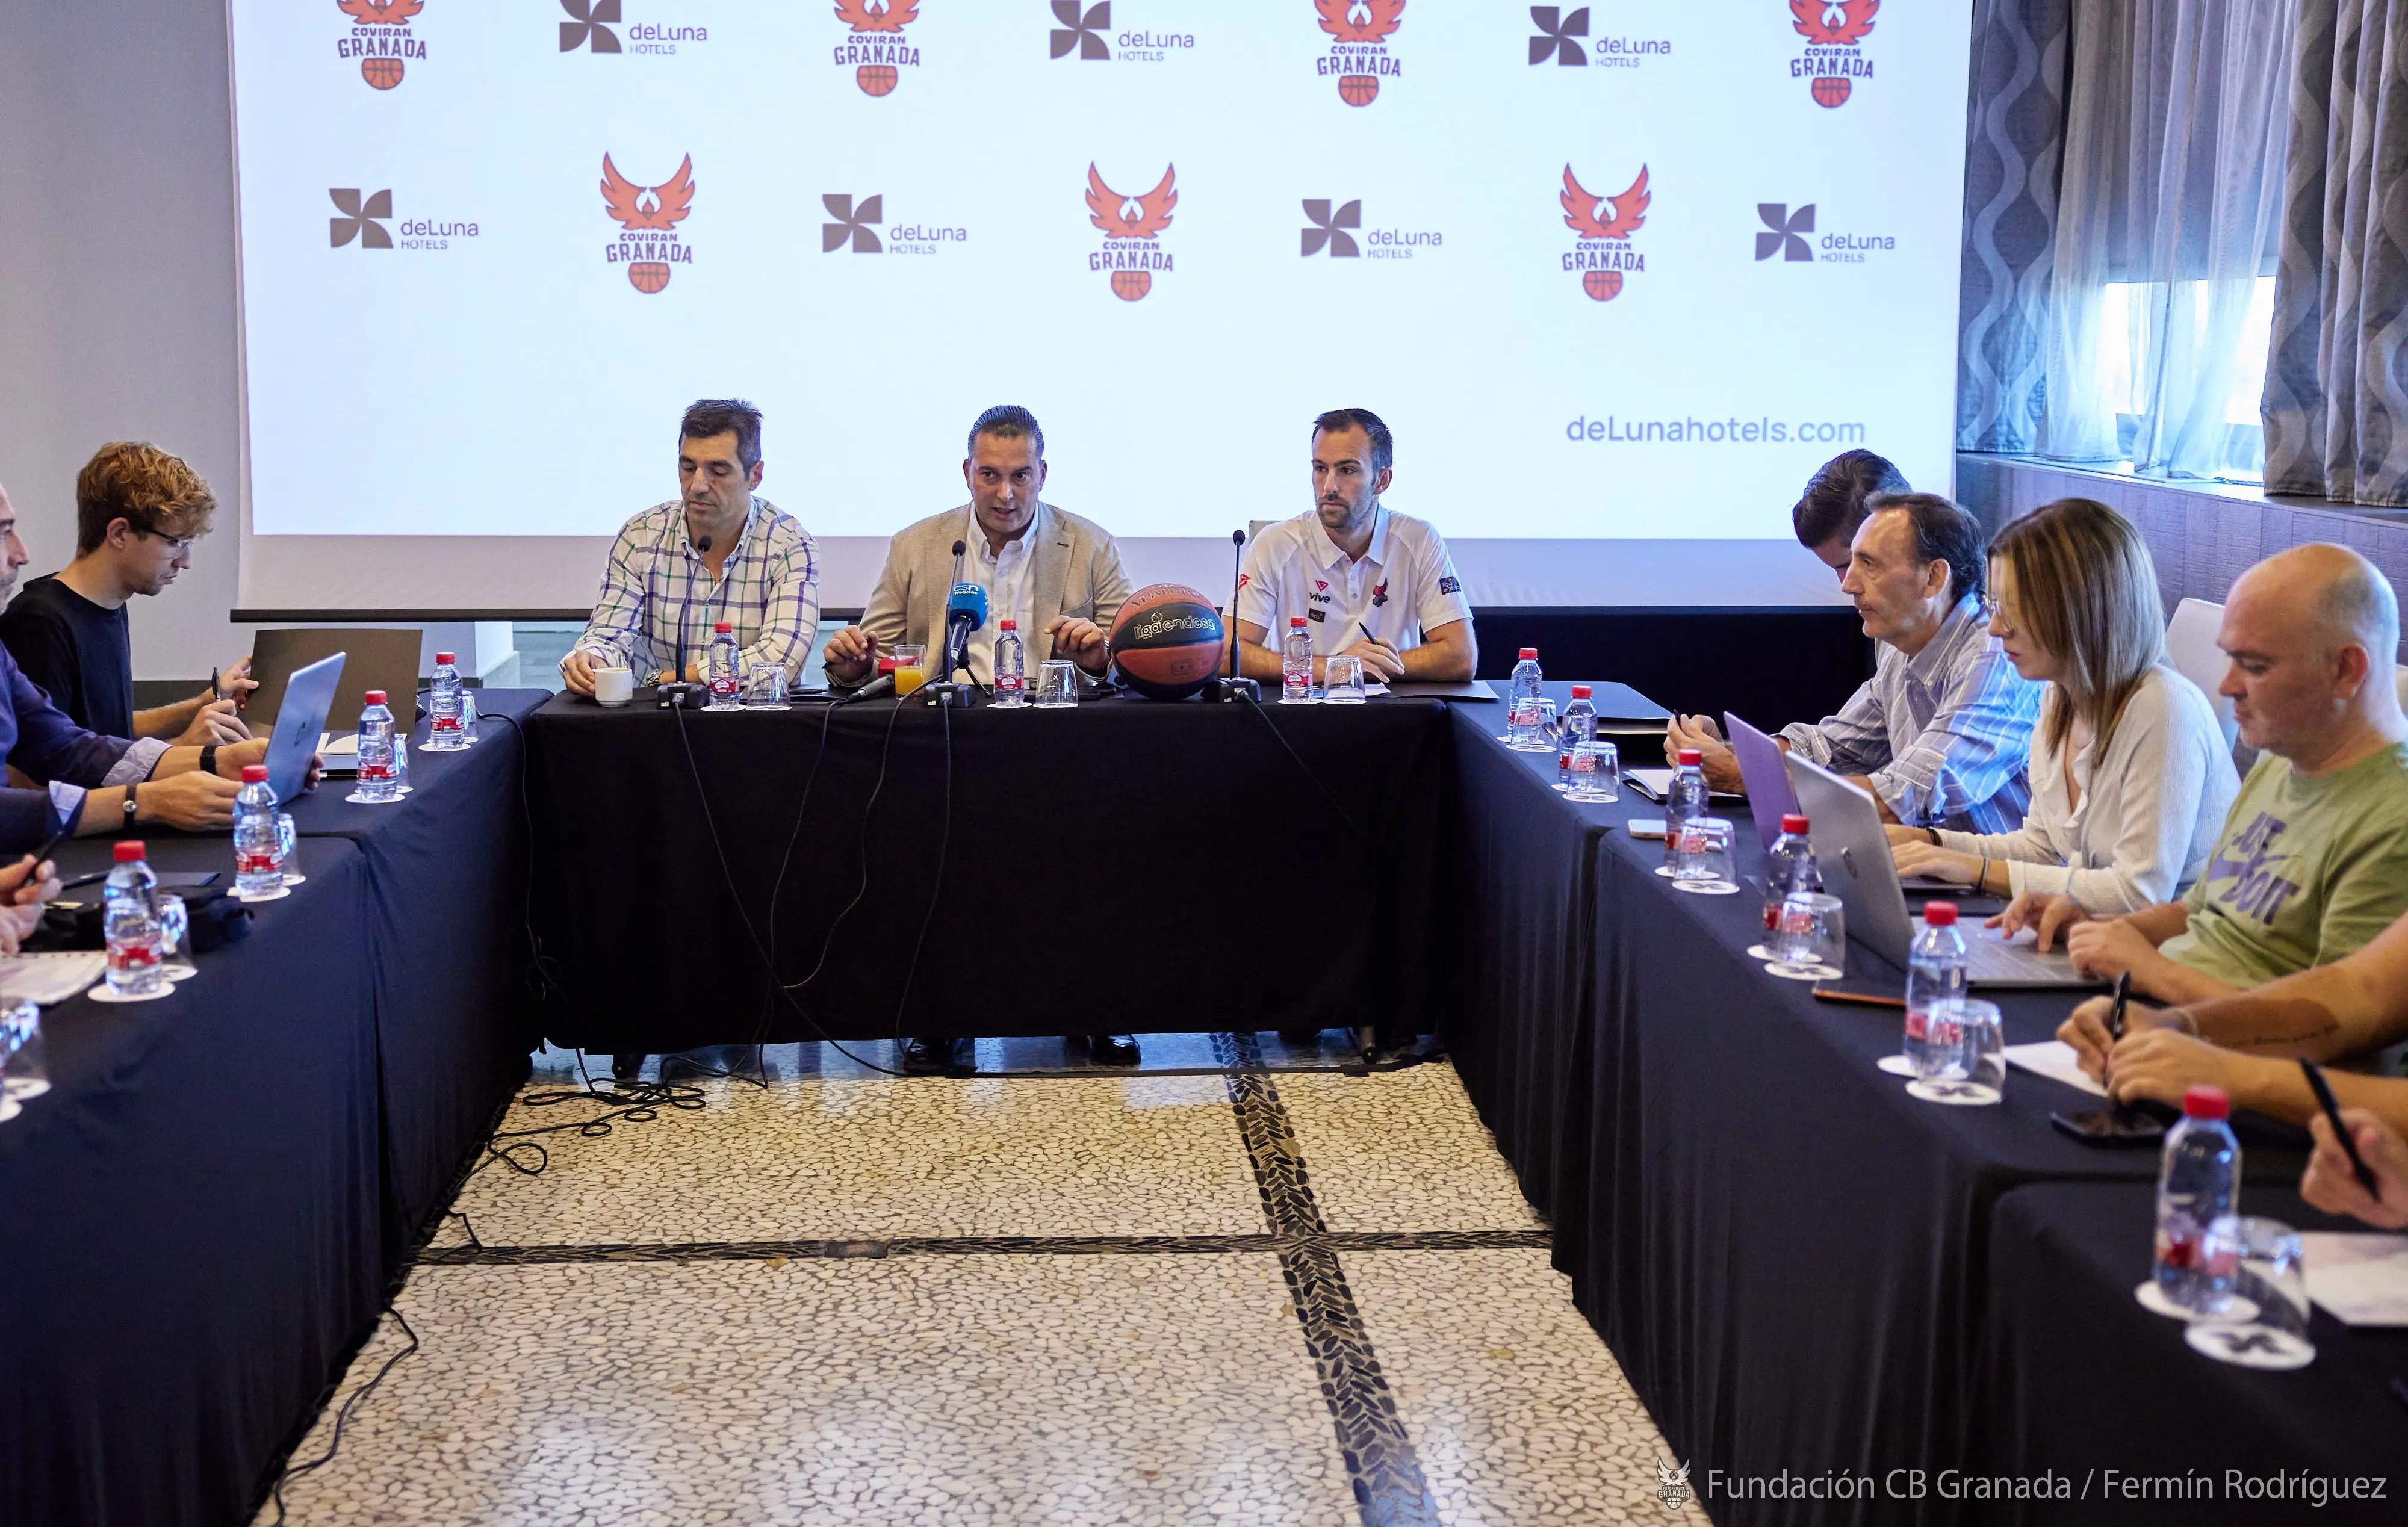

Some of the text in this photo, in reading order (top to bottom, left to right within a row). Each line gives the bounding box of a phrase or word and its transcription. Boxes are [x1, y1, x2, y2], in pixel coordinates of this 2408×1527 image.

[352, 27, 412, 37] COVIRAN
[630, 23, 707, 42] deLuna
[1118, 30, 1194, 48] deLuna
[848, 35, 905, 44] COVIRAN
[1597, 37, 1671, 54] deLuna
[338, 37, 427, 60] GRANADA
[630, 44, 676, 55] HOTELS
[1330, 46, 1387, 55] COVIRAN
[1804, 48, 1861, 57] COVIRAN
[834, 45, 920, 67] GRANADA
[1119, 51, 1164, 61] HOTELS
[1596, 57, 1640, 68] HOTELS
[1317, 55, 1401, 77] GRANADA
[1790, 57, 1874, 79] GRANADA
[400, 218, 479, 237] deLuna
[890, 224, 966, 242] deLuna
[401, 239, 448, 250] HOTELS
[619, 233, 677, 242] COVIRAN
[1368, 229, 1442, 246] deLuna
[1822, 232, 1895, 250] deLuna
[890, 244, 936, 254] HOTELS
[1103, 241, 1160, 250] COVIRAN
[1576, 242, 1631, 251] COVIRAN
[606, 243, 693, 264] GRANADA
[1368, 249, 1412, 258] HOTELS
[1821, 253, 1864, 262] HOTELS
[1089, 251, 1173, 273] GRANADA
[1562, 251, 1645, 272] GRANADA
[1566, 415, 1865, 443] deLunahotels.com
[1309, 592, 1330, 603] vive
